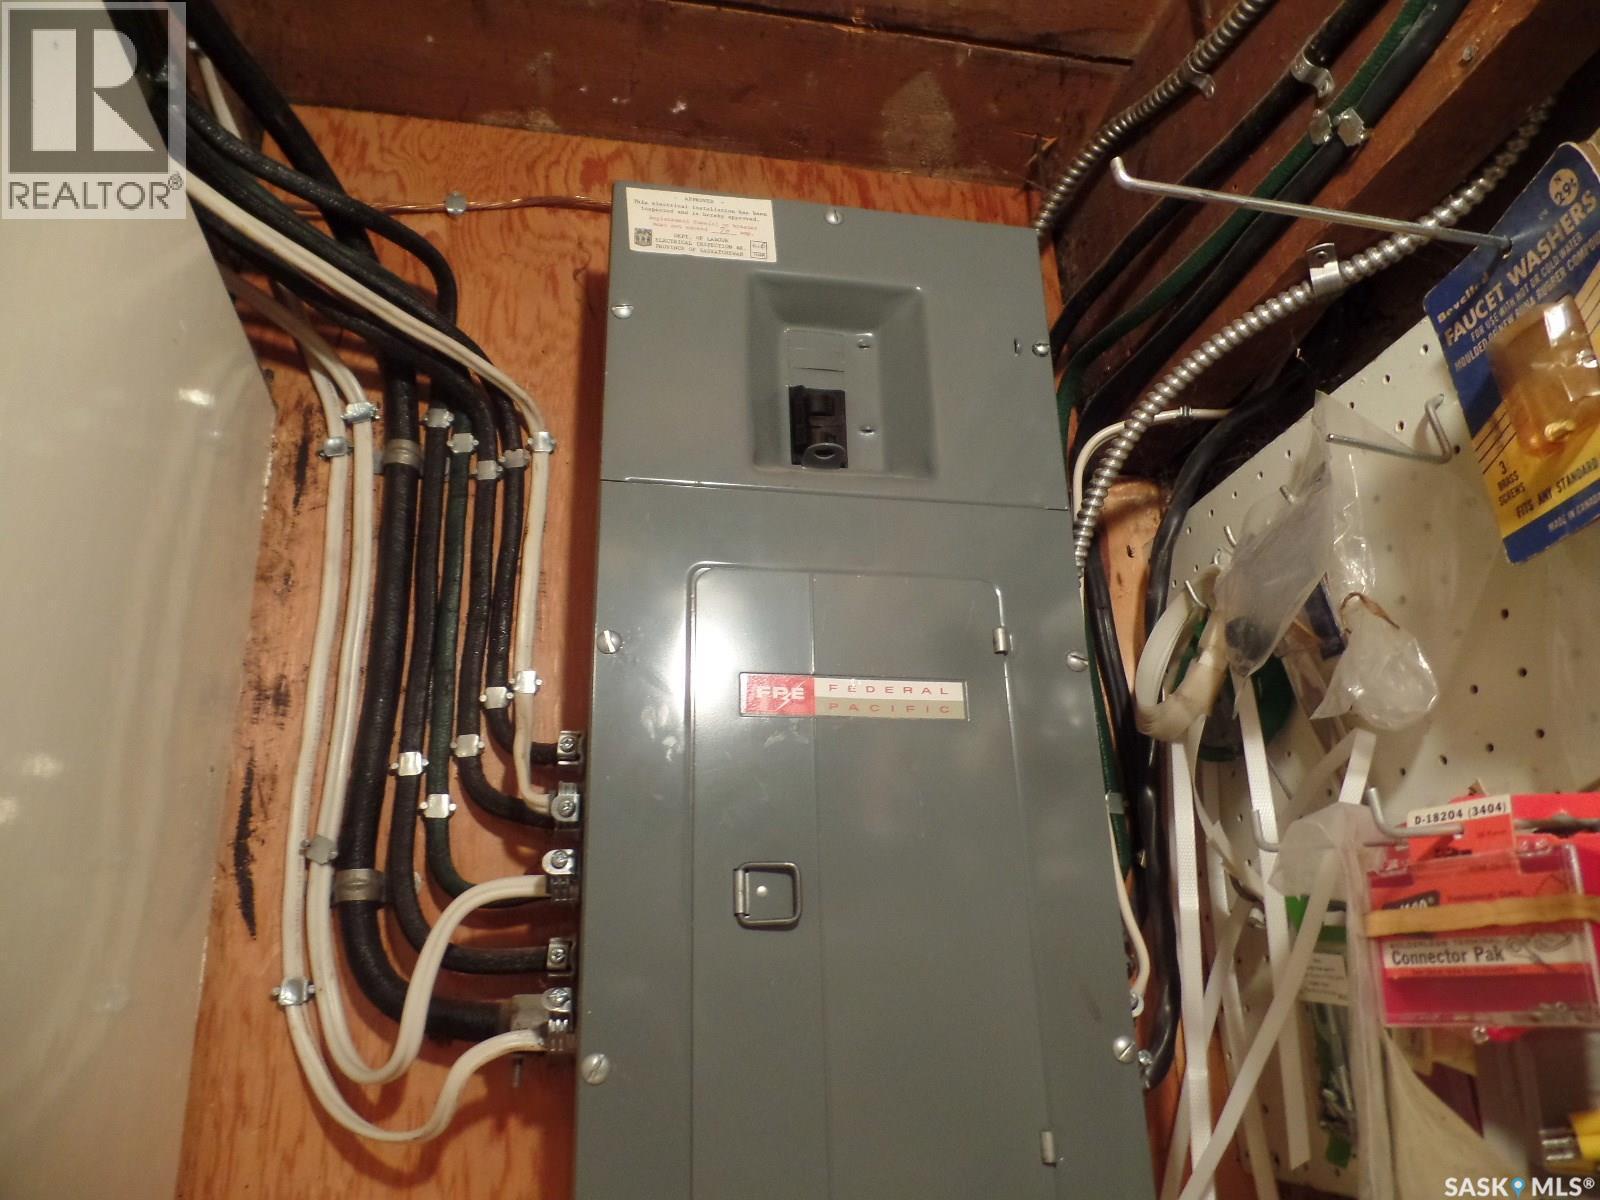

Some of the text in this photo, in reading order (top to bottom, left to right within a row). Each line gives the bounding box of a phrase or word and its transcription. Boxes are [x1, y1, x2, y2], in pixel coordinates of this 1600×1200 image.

[651, 201, 688, 209] electrical
[692, 205, 736, 214] installation
[1444, 190, 1597, 345] FAUCET WASHERS
[1499, 460, 1507, 475] 3
[1498, 482, 1526, 507] SCREWS
[1516, 457, 1599, 519] FITS ANY STANDARD
[828, 683, 949, 696] FEDERAL
[828, 702, 950, 714] PACIFIC
[1414, 801, 1507, 826] D-18204 (3404)
[1391, 945, 1505, 966] Connector Pak
